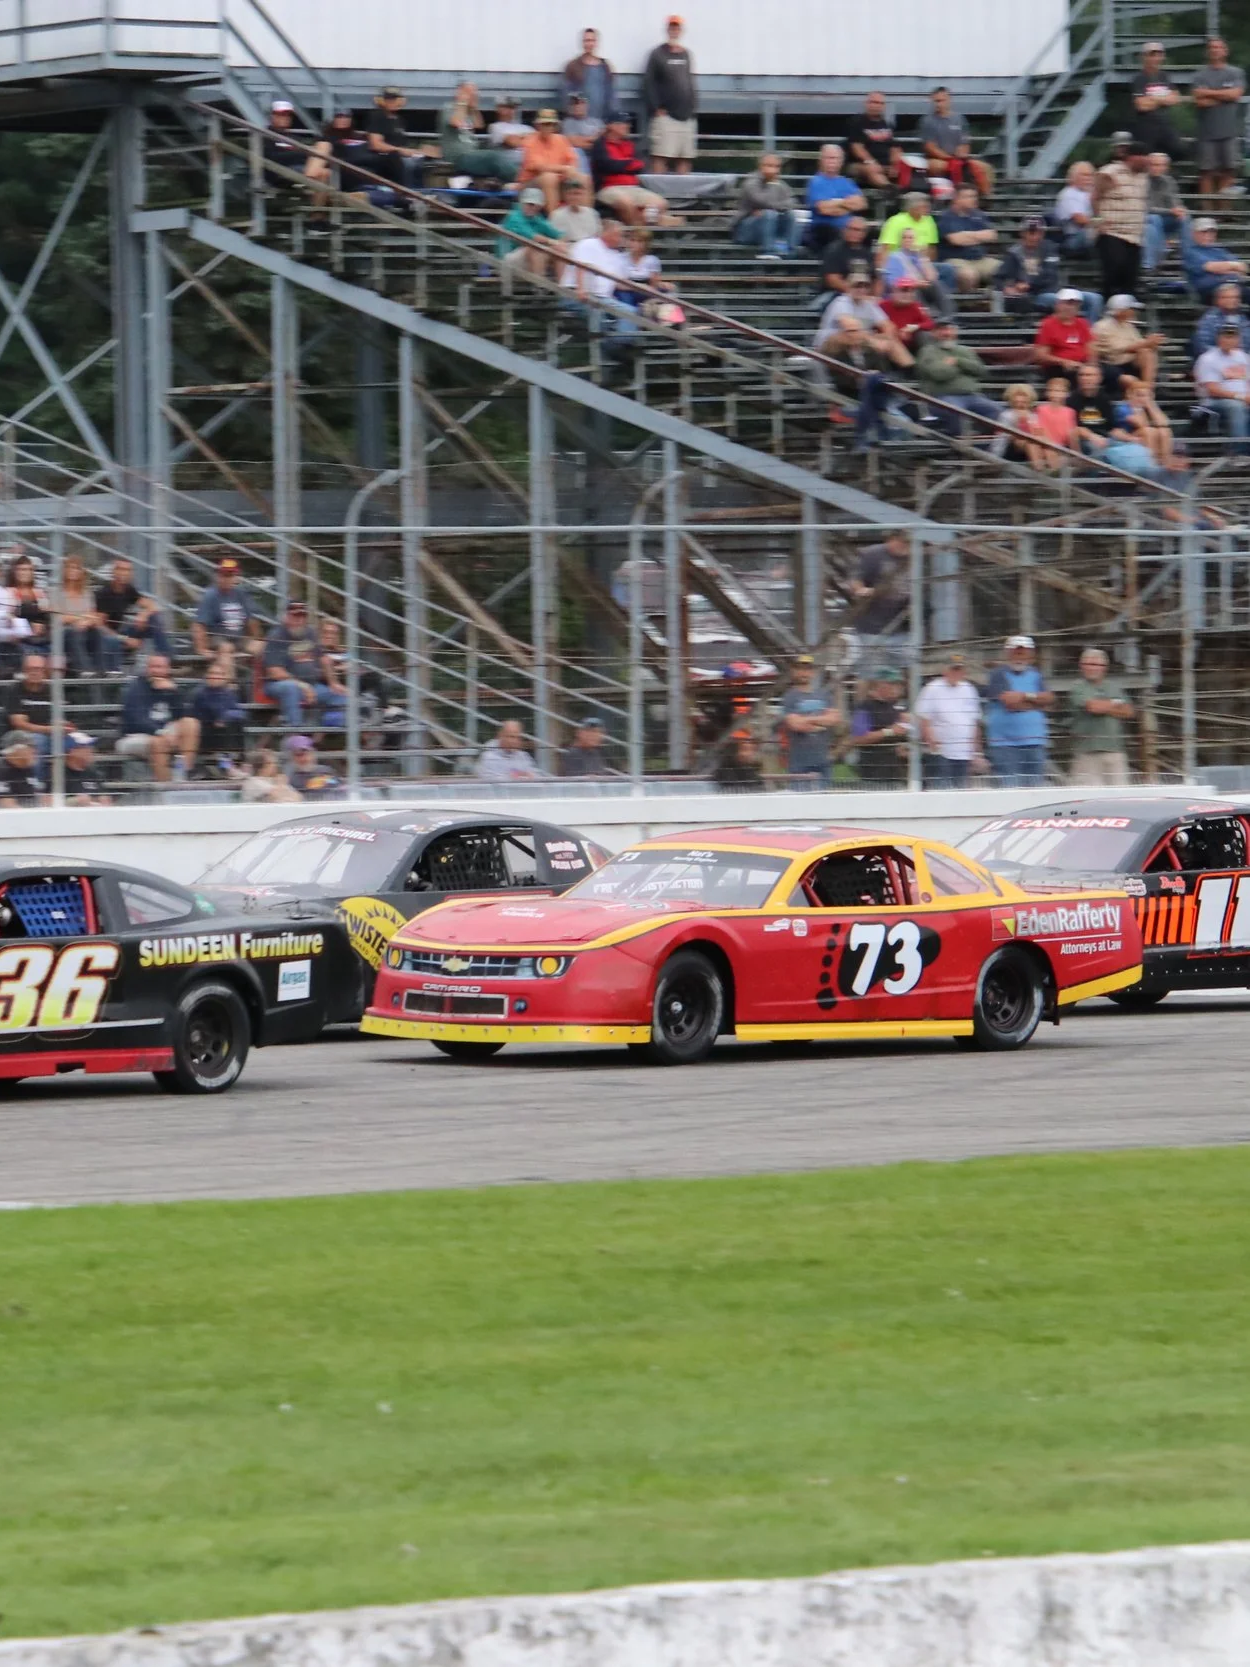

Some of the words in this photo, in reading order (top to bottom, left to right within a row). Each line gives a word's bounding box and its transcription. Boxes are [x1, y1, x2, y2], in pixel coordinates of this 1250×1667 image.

[1010, 817, 1131, 829] FANNING
[315, 826, 377, 842] MICHAEL
[618, 852, 641, 862] 73
[1015, 901, 1122, 937] EdenRafferty
[139, 935, 235, 967] SUNDEEN
[240, 932, 324, 959] Furniture
[1060, 941, 1097, 955] Attorneys
[1098, 941, 1106, 951] at
[1107, 939, 1122, 951] Law
[849, 920, 923, 996] 73
[422, 982, 482, 993] CAMARO
